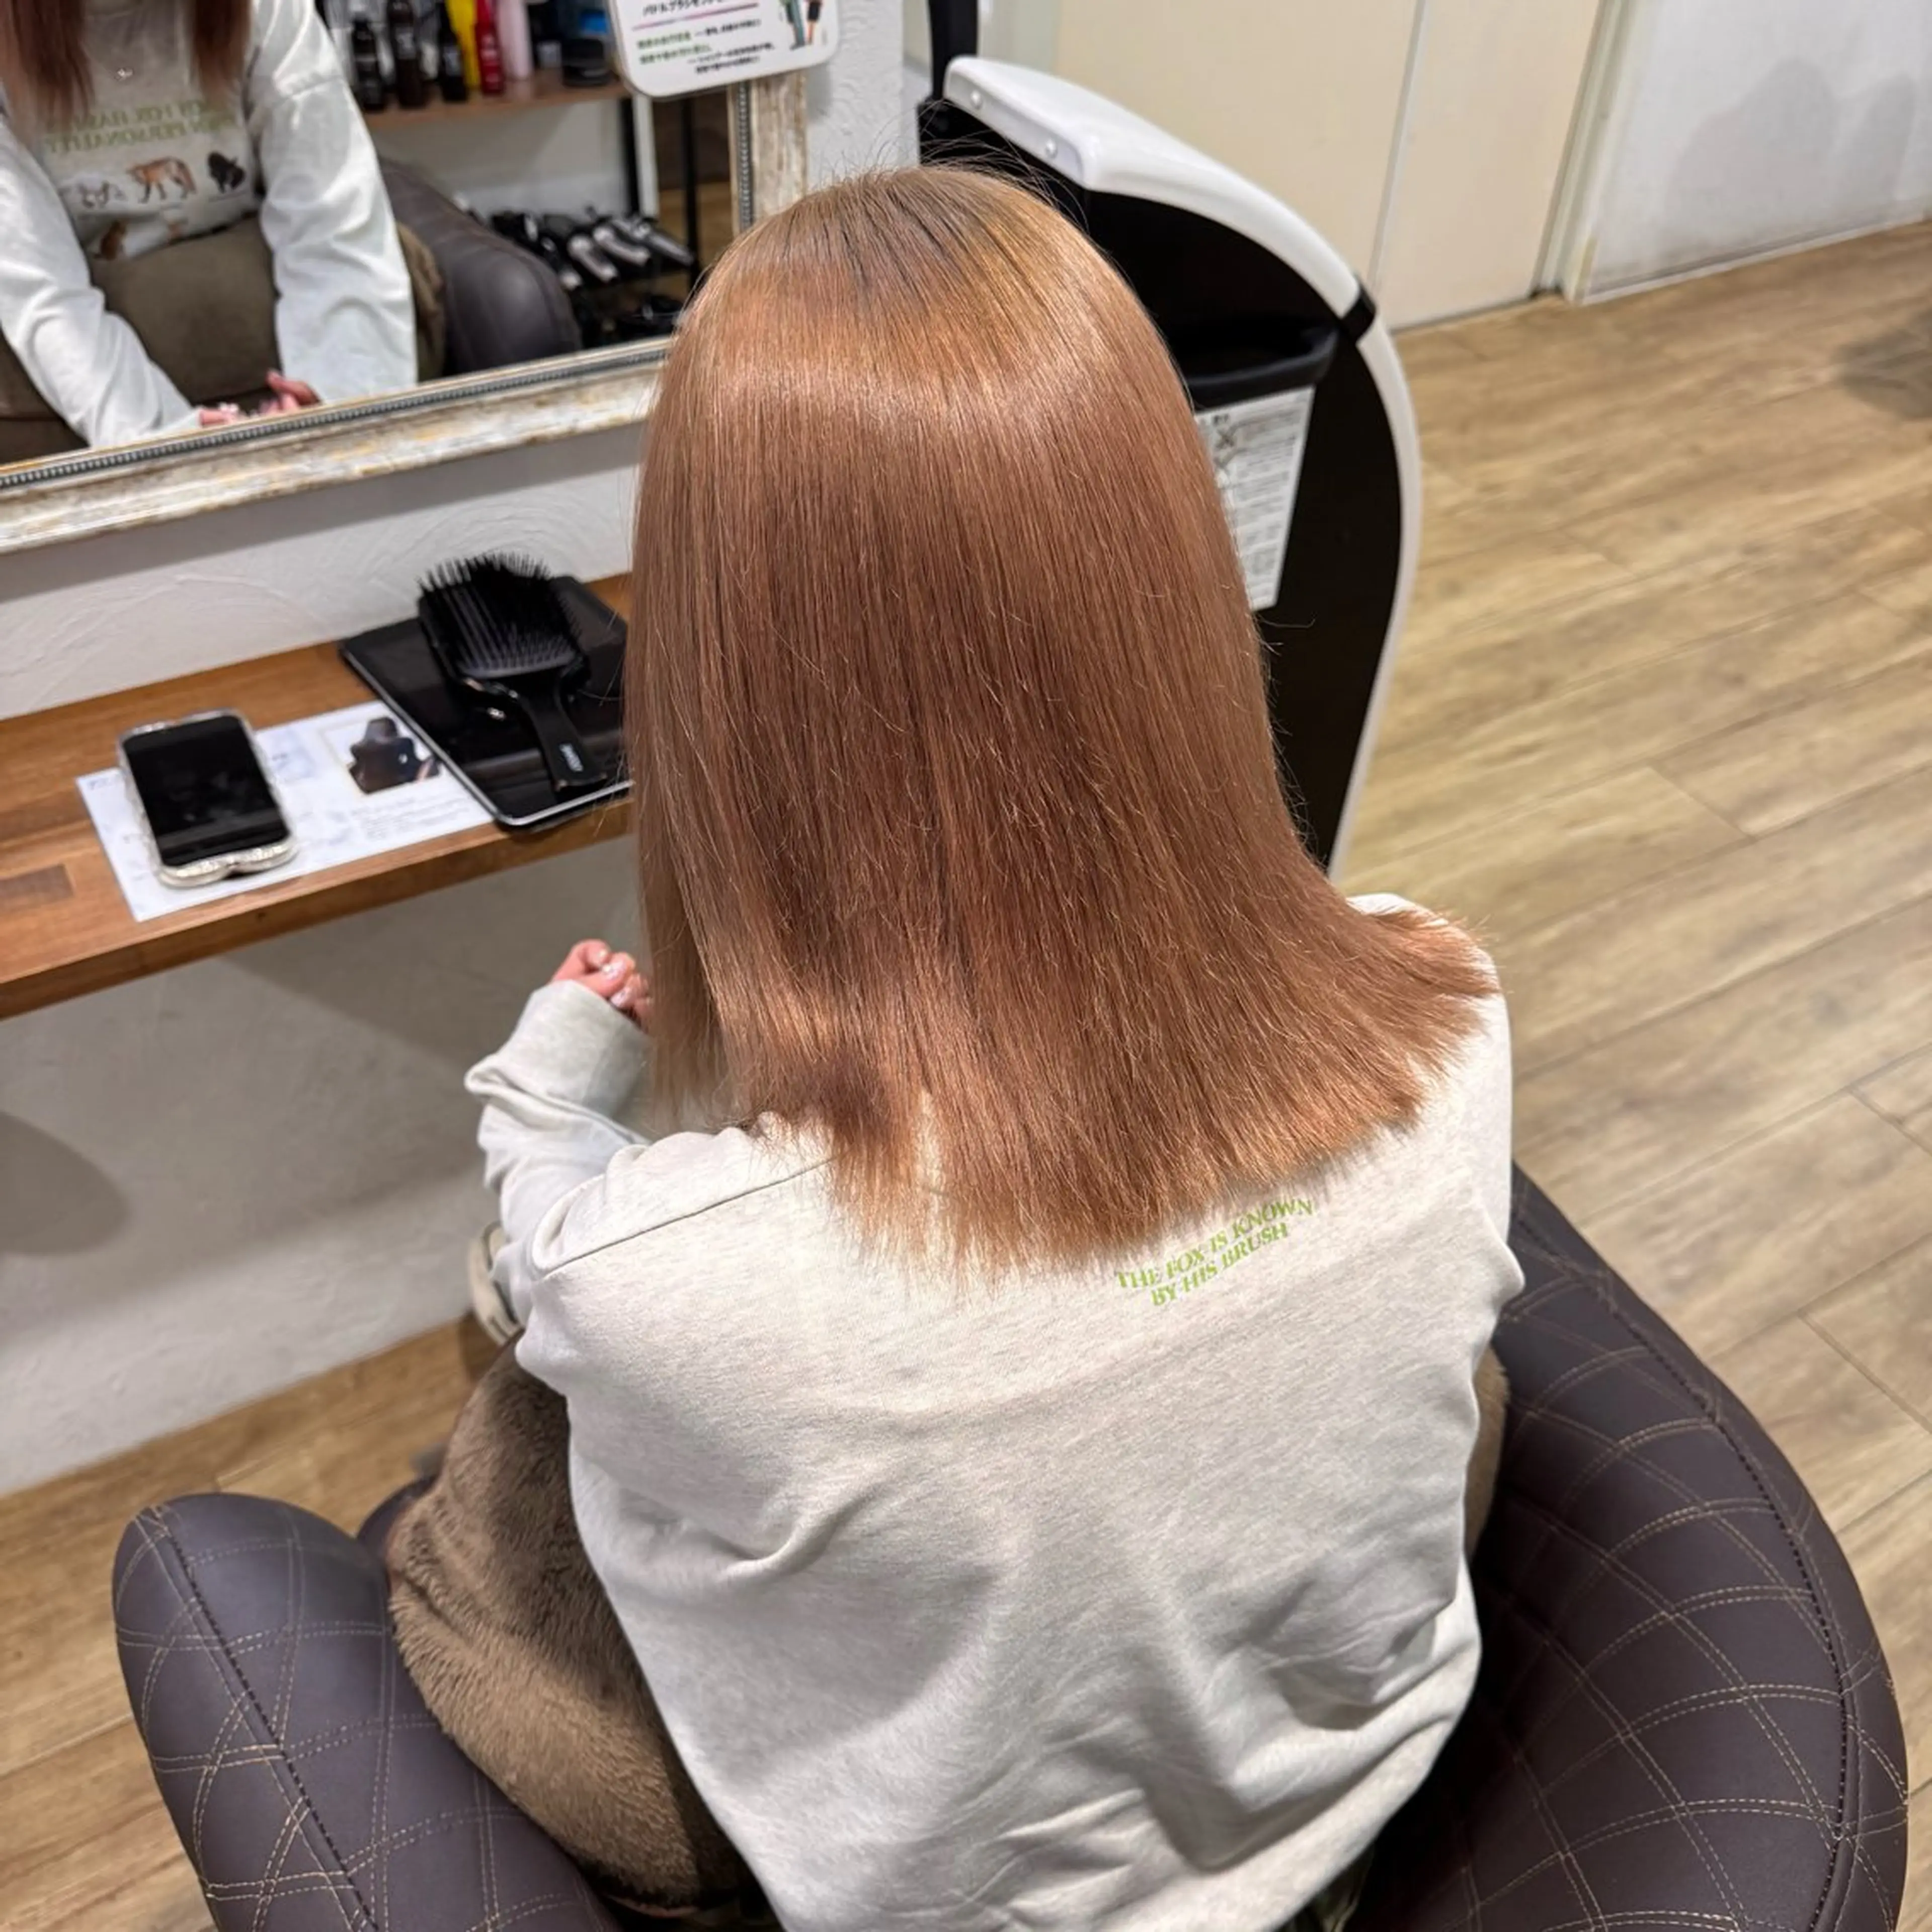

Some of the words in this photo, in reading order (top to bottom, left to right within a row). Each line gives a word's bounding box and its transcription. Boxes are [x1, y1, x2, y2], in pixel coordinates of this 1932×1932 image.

[1117, 1268, 1162, 1289] THE
[1166, 1248, 1208, 1278] FOX
[1210, 1230, 1228, 1253] IS
[1231, 1199, 1314, 1239] KNOWN
[1151, 1282, 1176, 1307] BY
[1182, 1260, 1218, 1292] HIS
[1221, 1222, 1289, 1269] BRUSH
